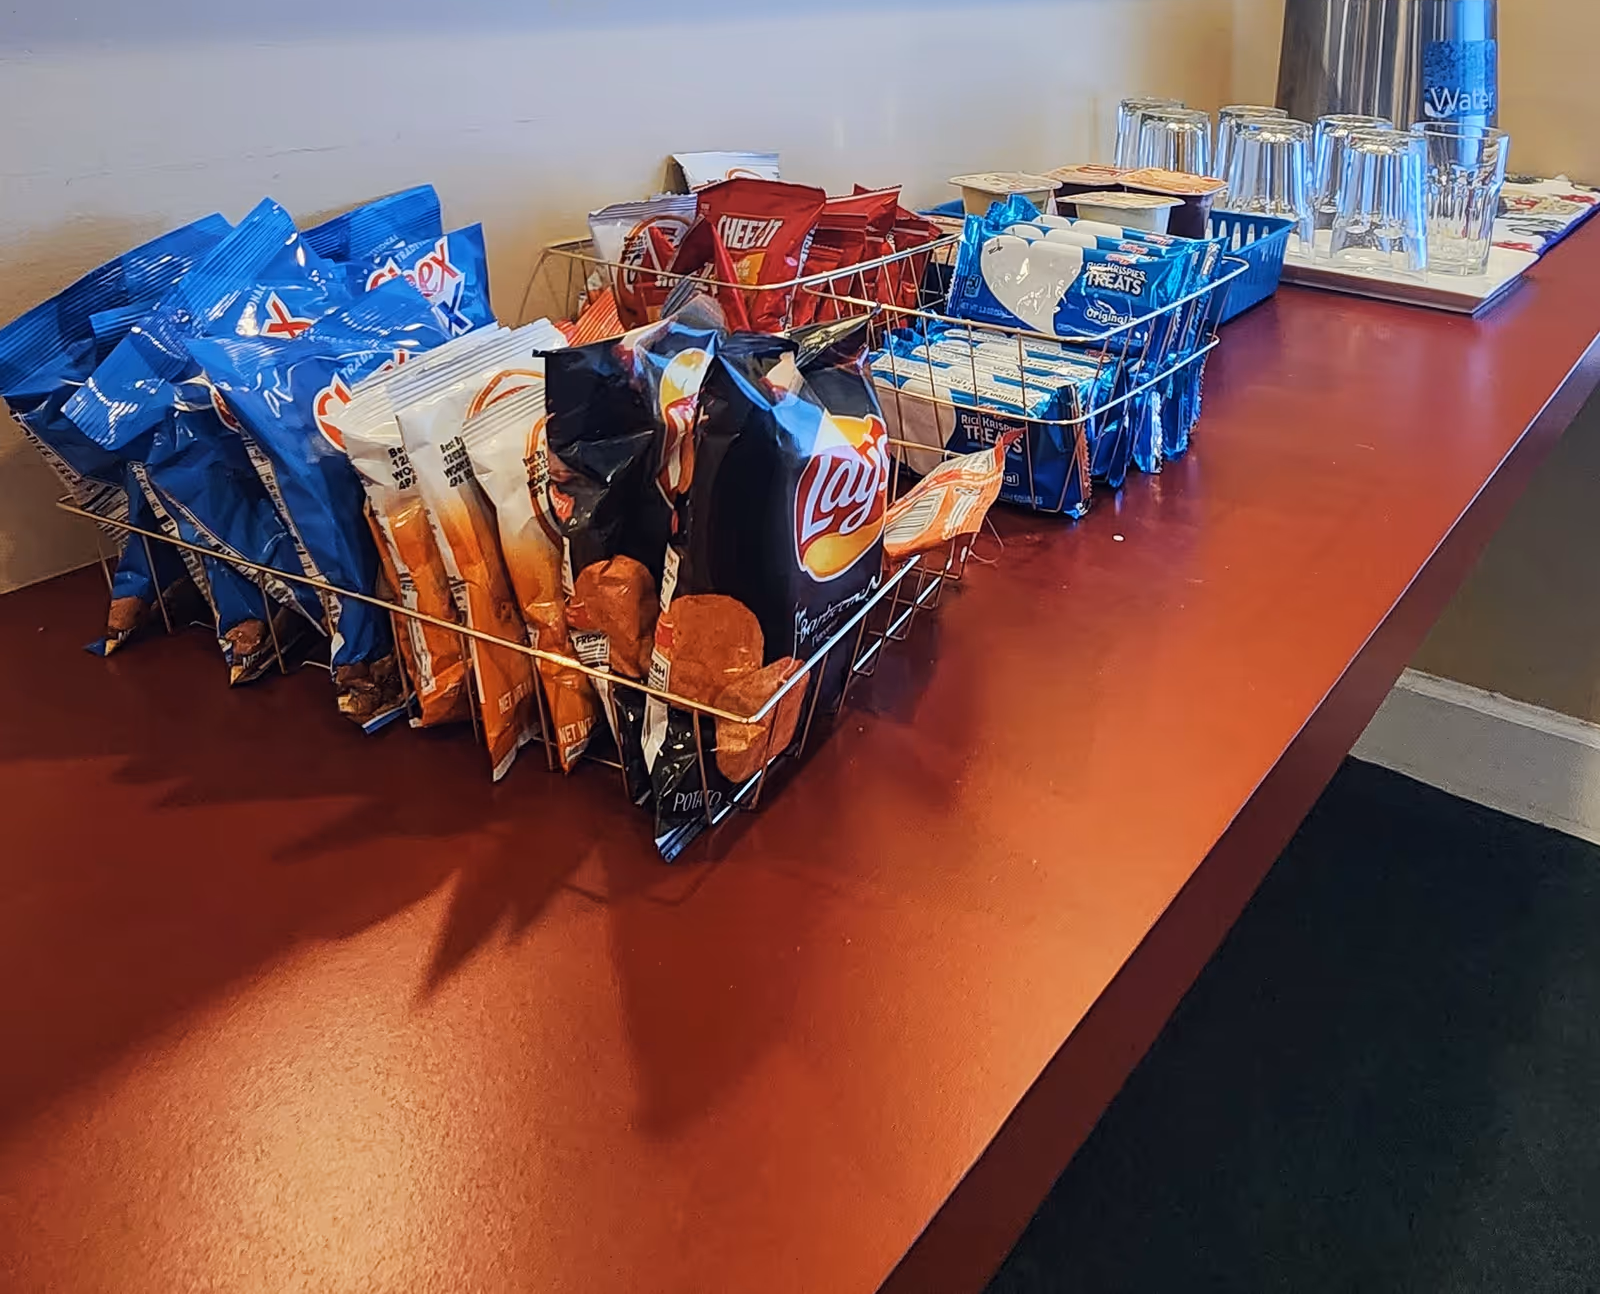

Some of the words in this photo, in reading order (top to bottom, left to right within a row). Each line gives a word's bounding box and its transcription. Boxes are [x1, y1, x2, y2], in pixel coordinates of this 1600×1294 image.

[1430, 86, 1494, 112] Water
[1087, 271, 1142, 296] TREATS
[1086, 306, 1129, 325] Original
[961, 414, 980, 425] RIC
[963, 424, 1023, 454] TREAS
[800, 433, 890, 546] Lay's
[557, 723, 578, 744] NET
